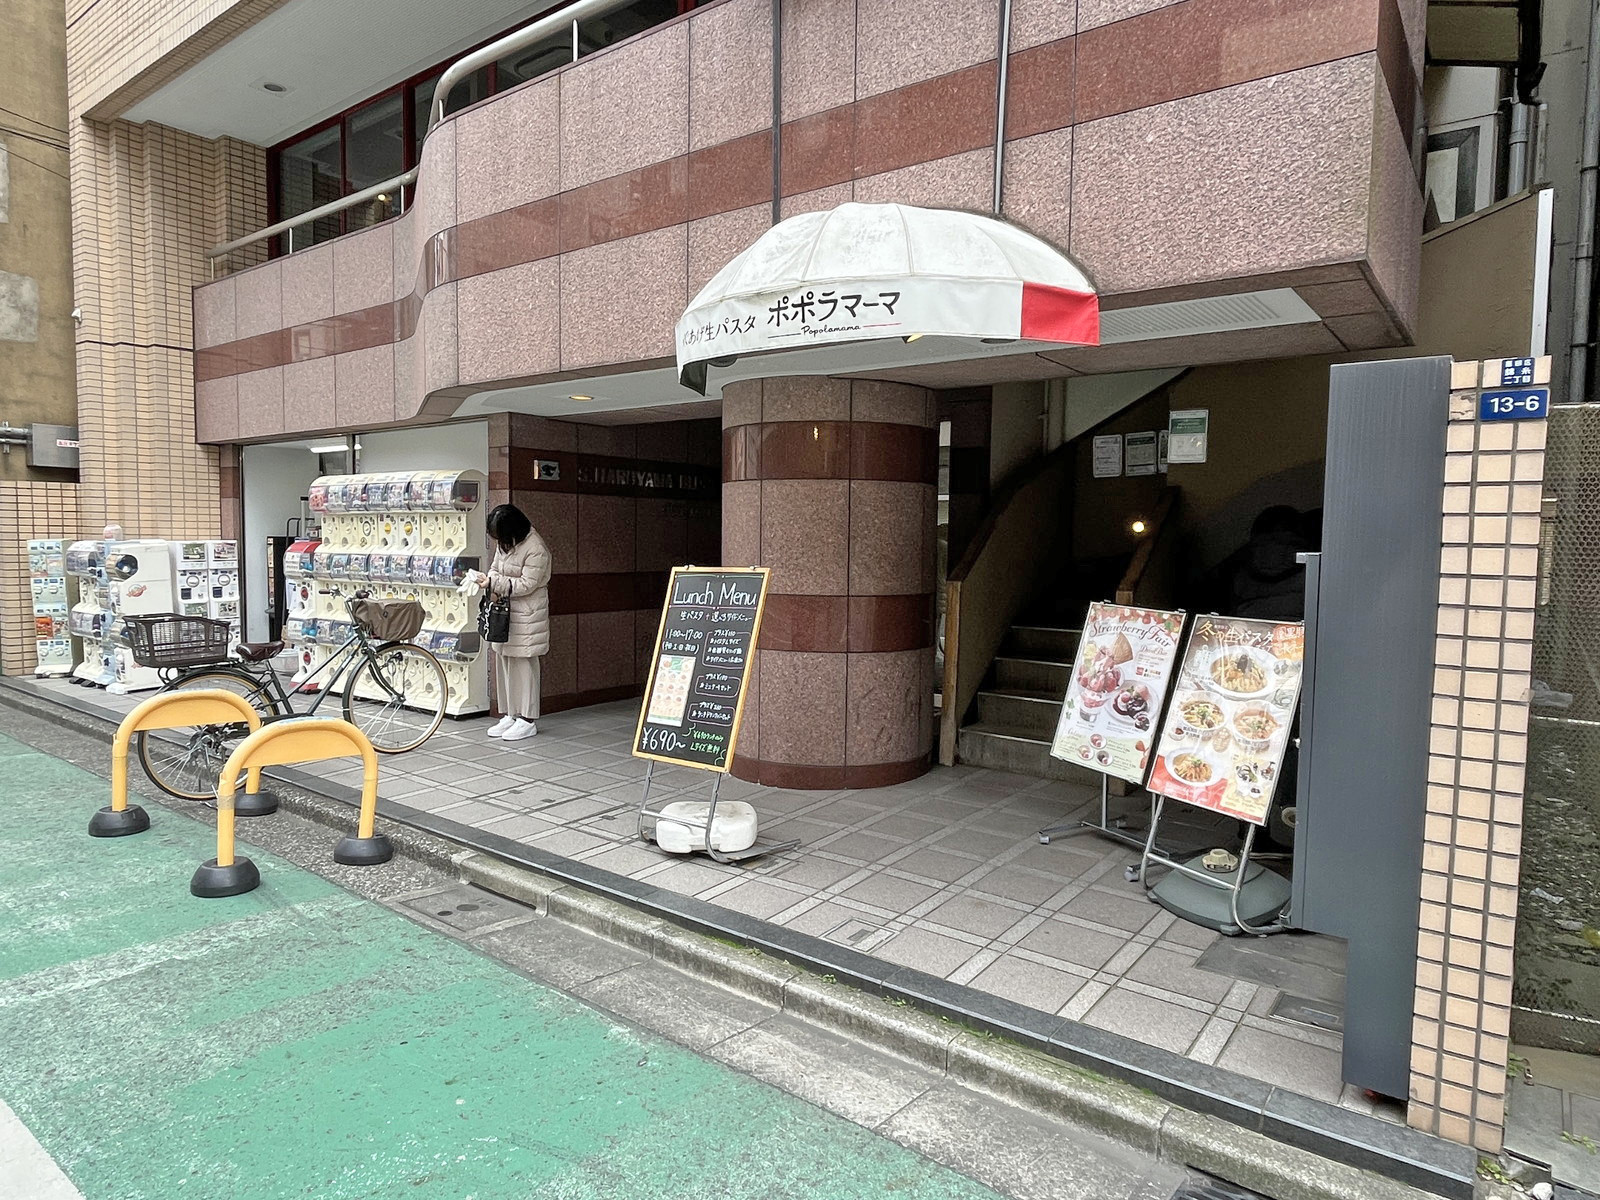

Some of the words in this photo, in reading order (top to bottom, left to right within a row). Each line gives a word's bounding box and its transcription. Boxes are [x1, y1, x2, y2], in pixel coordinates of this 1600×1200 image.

[767, 291, 901, 327] ポポラマーマ
[800, 325, 862, 337] Popolamama
[1490, 395, 1540, 413] 13-6
[673, 581, 714, 605] Lunch
[719, 582, 757, 605] Menu
[1089, 621, 1149, 640] Strawberry
[1147, 625, 1172, 648] Fair
[1195, 620, 1275, 646] 冬の生パスタ
